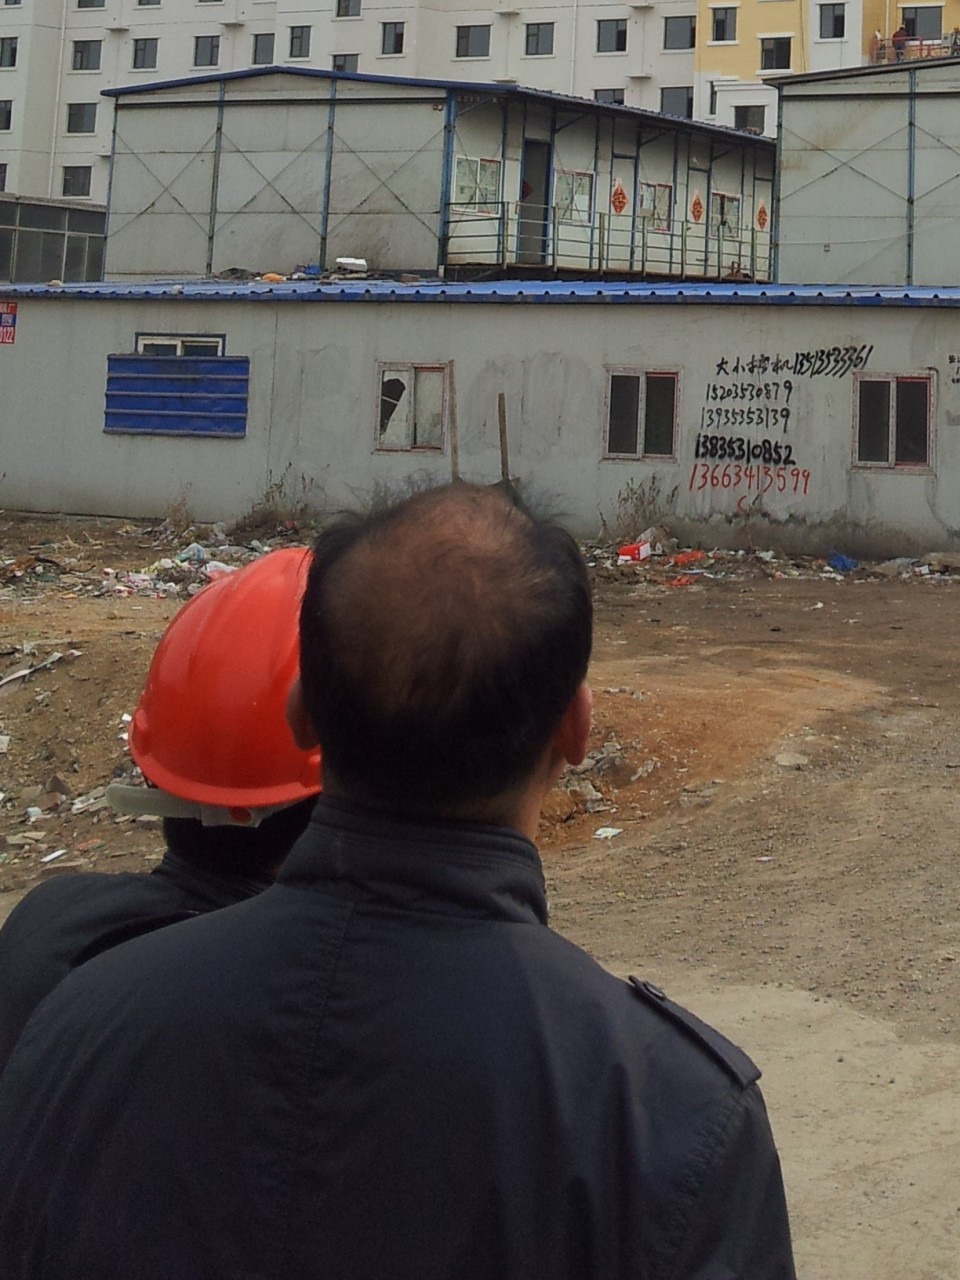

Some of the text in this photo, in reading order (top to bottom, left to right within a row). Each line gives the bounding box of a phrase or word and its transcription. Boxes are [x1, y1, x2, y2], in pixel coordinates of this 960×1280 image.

[706, 380, 793, 404] 15203530879
[701, 406, 790, 434] 13935353139
[695, 432, 796, 466] 13835310852
[689, 463, 811, 495] 13663413599
